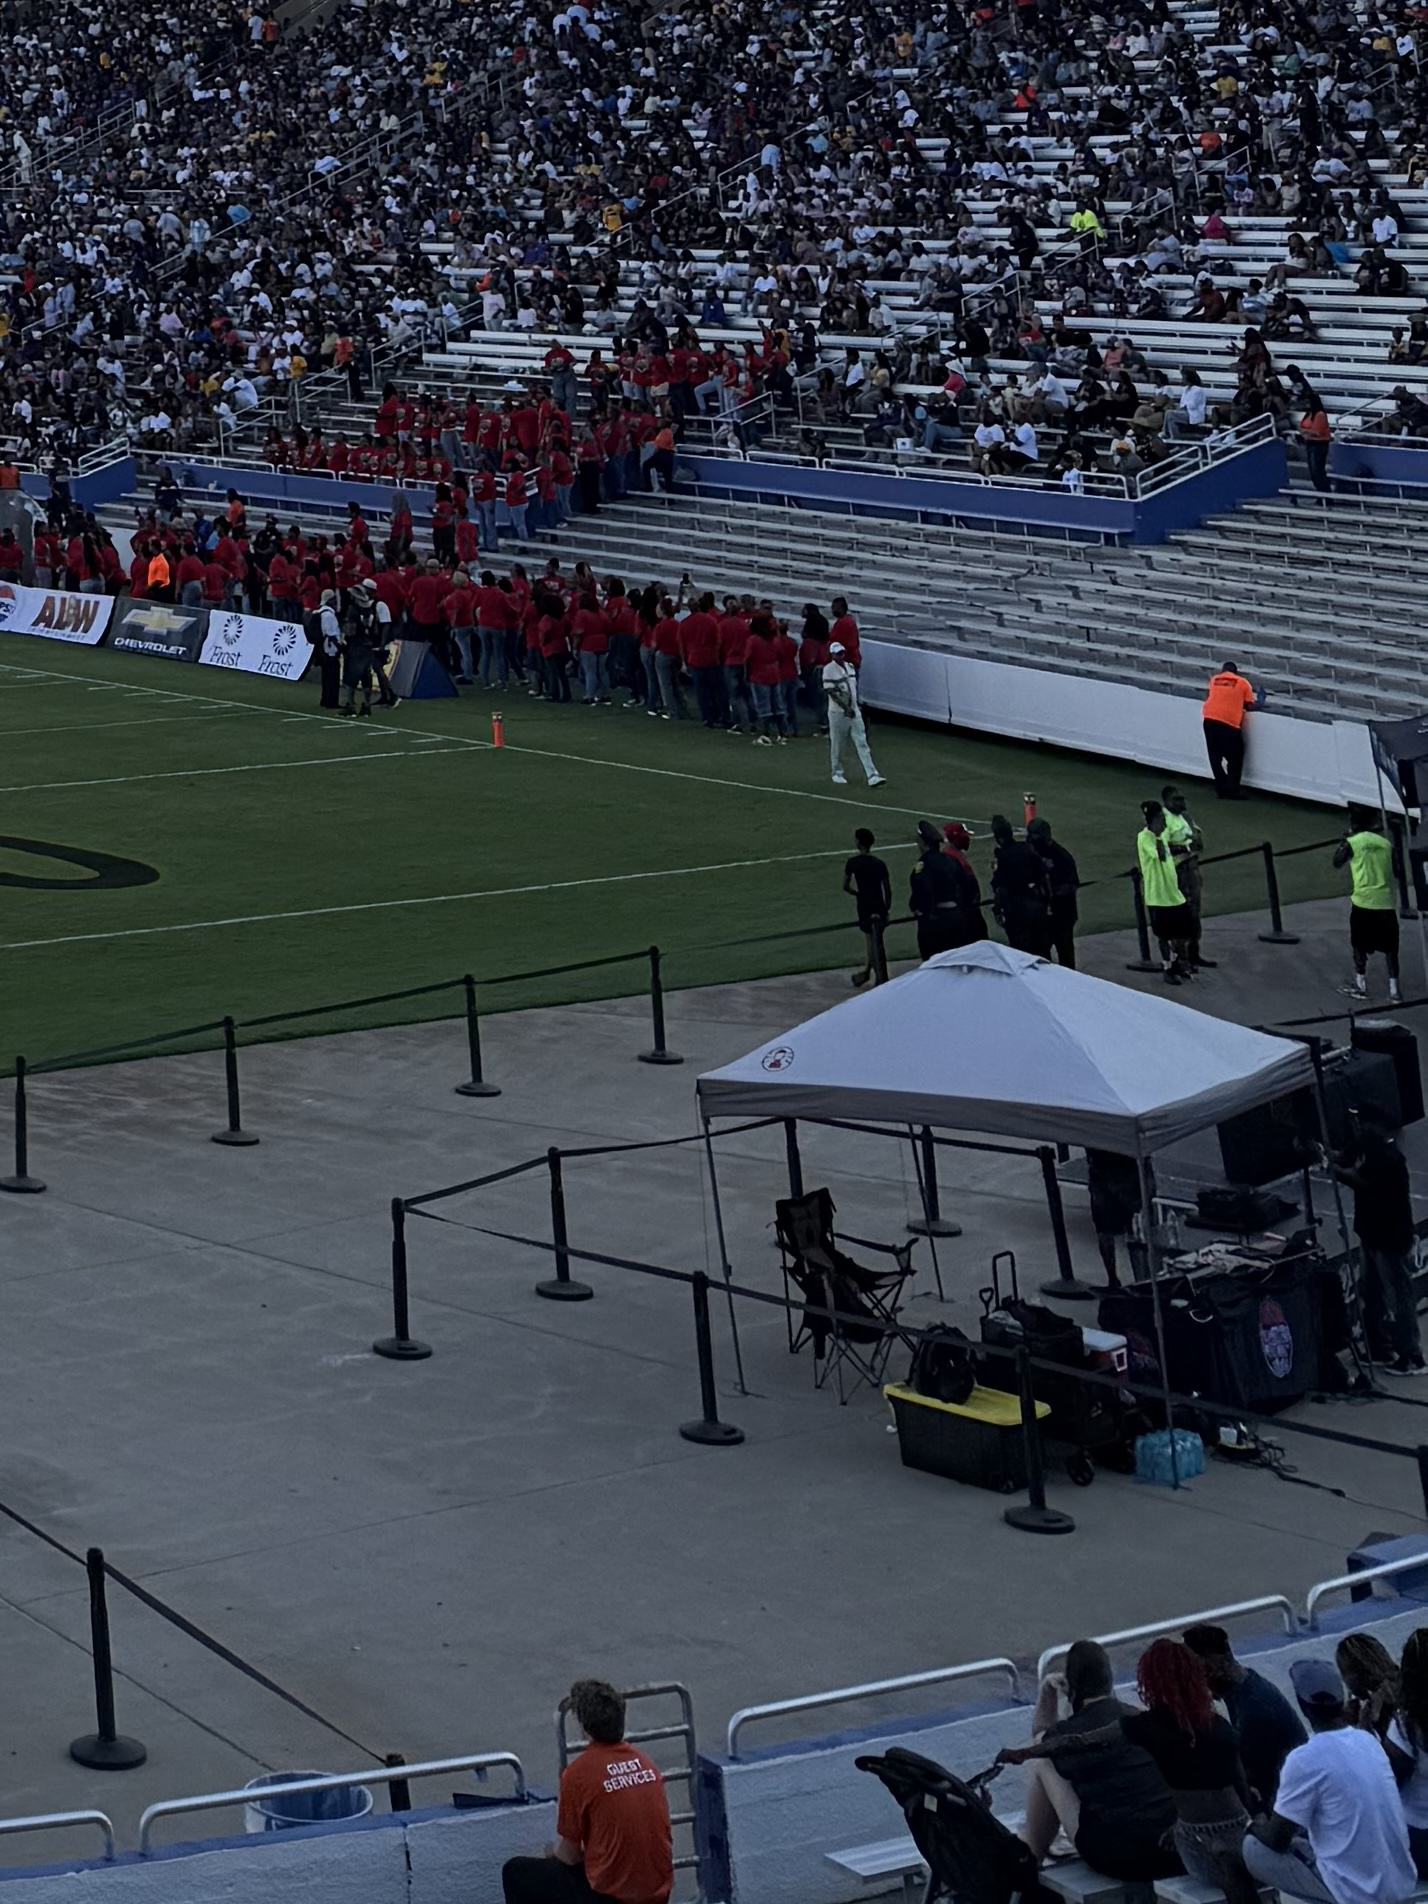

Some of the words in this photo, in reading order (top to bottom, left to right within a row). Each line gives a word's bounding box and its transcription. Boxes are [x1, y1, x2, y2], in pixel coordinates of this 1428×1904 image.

[209, 645, 243, 667] Frost
[257, 654, 294, 677] Frost
[606, 1758, 643, 1775] GUEST
[603, 1768, 657, 1793] SERVICES
